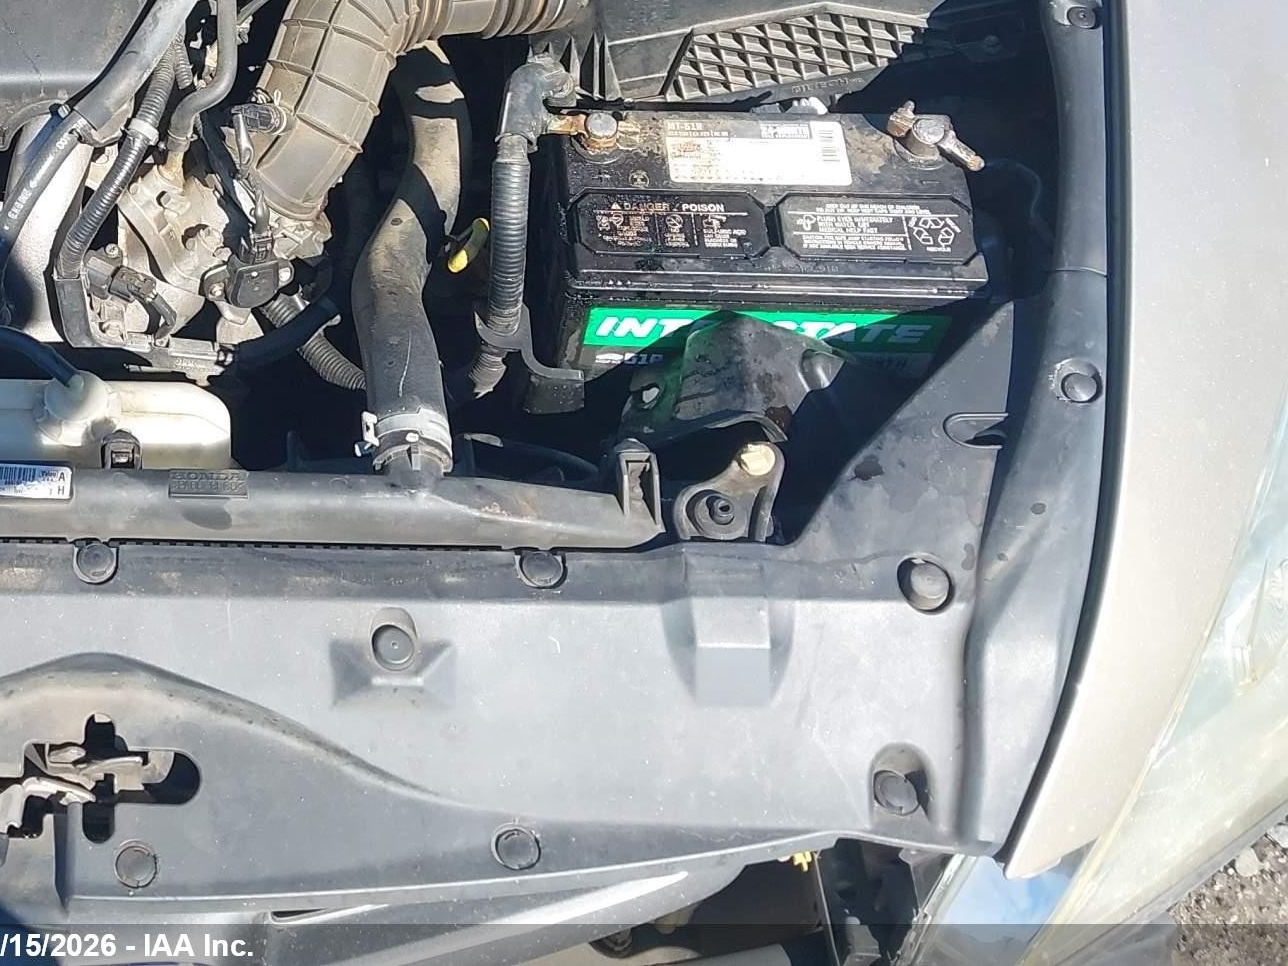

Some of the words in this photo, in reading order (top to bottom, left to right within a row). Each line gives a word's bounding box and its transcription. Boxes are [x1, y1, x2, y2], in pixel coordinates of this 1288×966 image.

[623, 202, 671, 211] DANGER
[682, 203, 725, 212] POISON
[596, 316, 932, 343] INTTATE
[59, 472, 65, 482] A
[58, 486, 65, 495] H
